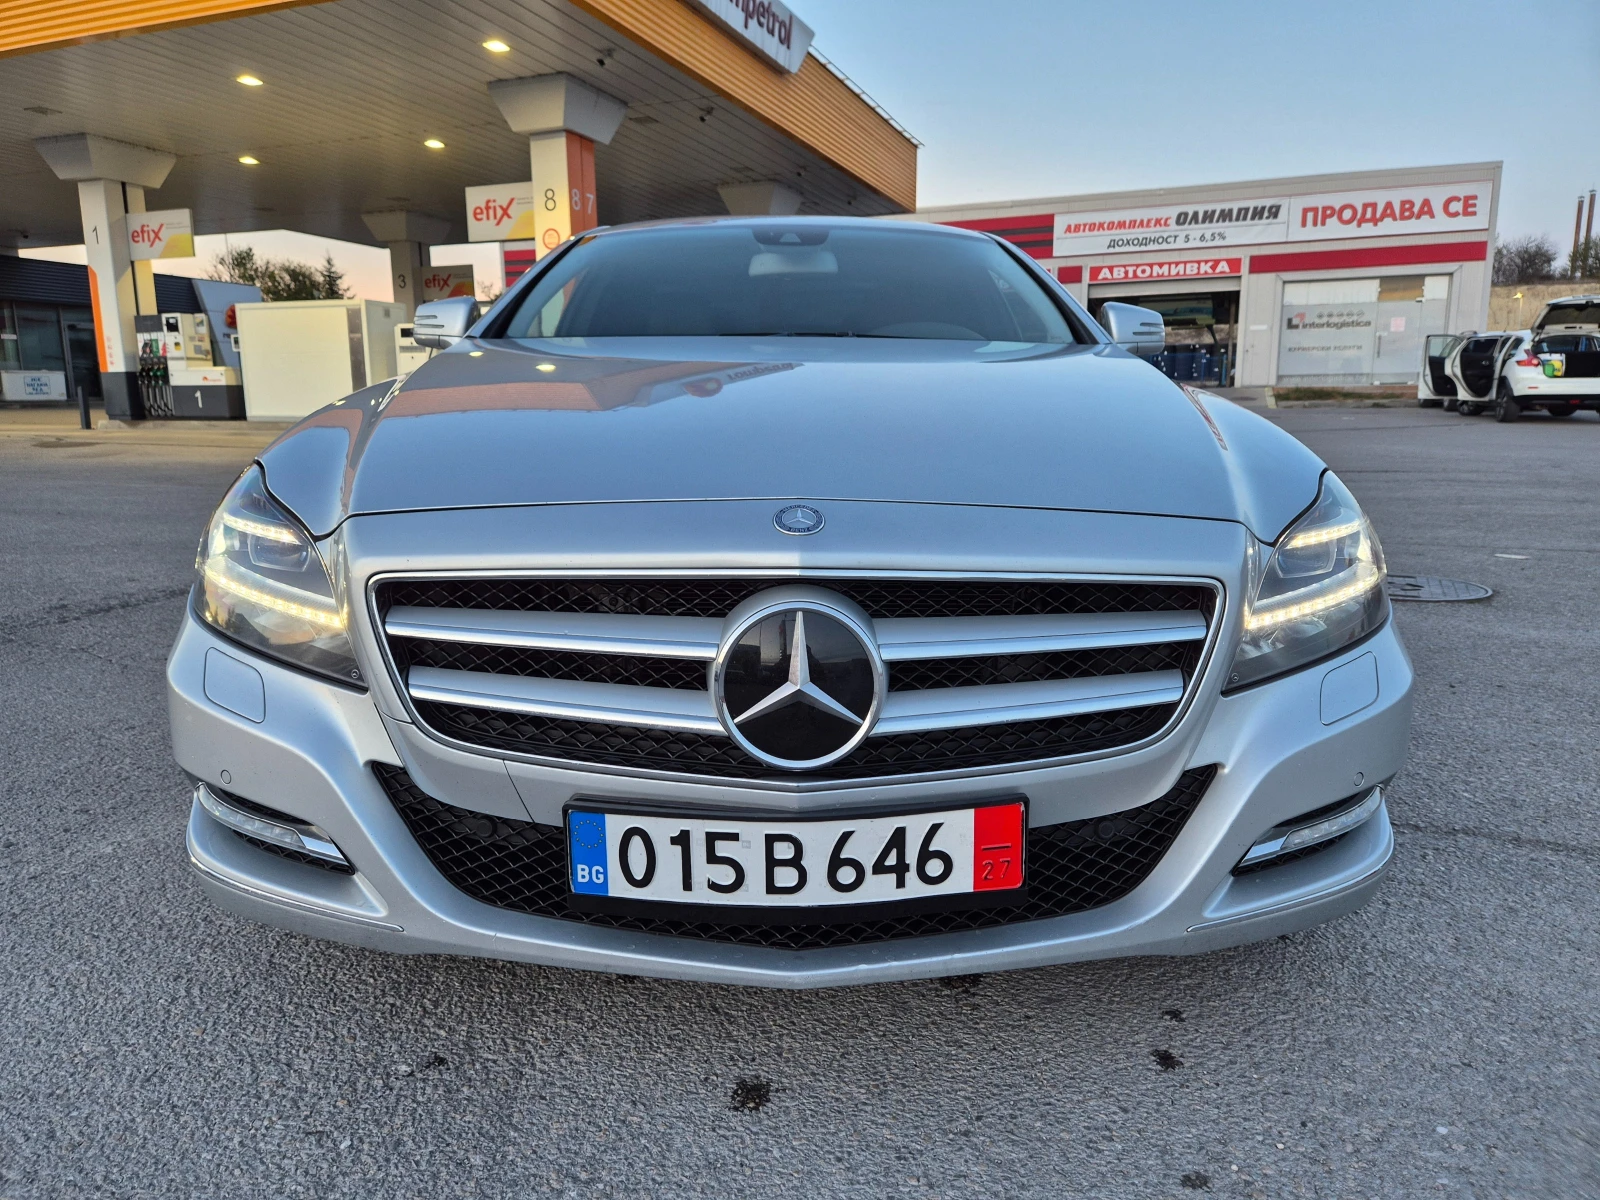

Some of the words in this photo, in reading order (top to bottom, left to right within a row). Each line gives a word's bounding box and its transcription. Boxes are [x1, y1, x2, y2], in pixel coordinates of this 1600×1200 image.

[544, 188, 557, 211] 8
[571, 188, 581, 211] 8
[586, 193, 594, 215] 7
[472, 197, 515, 227] efix
[1064, 216, 1171, 234] АВТОКОМПЛЕКС
[1175, 204, 1282, 227] ОЛИМПИЯ
[1301, 198, 1435, 228] ПРОДАВА
[1442, 194, 1478, 218] СЕ
[92, 225, 99, 245] 1
[131, 223, 165, 248] efix
[1106, 234, 1180, 250] ДОХОДНОСТ
[1184, 234, 1191, 244] 5
[1097, 260, 1231, 280] АВТОМИВКА
[398, 274, 406, 289] 3
[424, 273, 452, 292] efix
[194, 390, 203, 408] 1
[576, 864, 604, 884] BG
[981, 857, 1011, 881] 27
